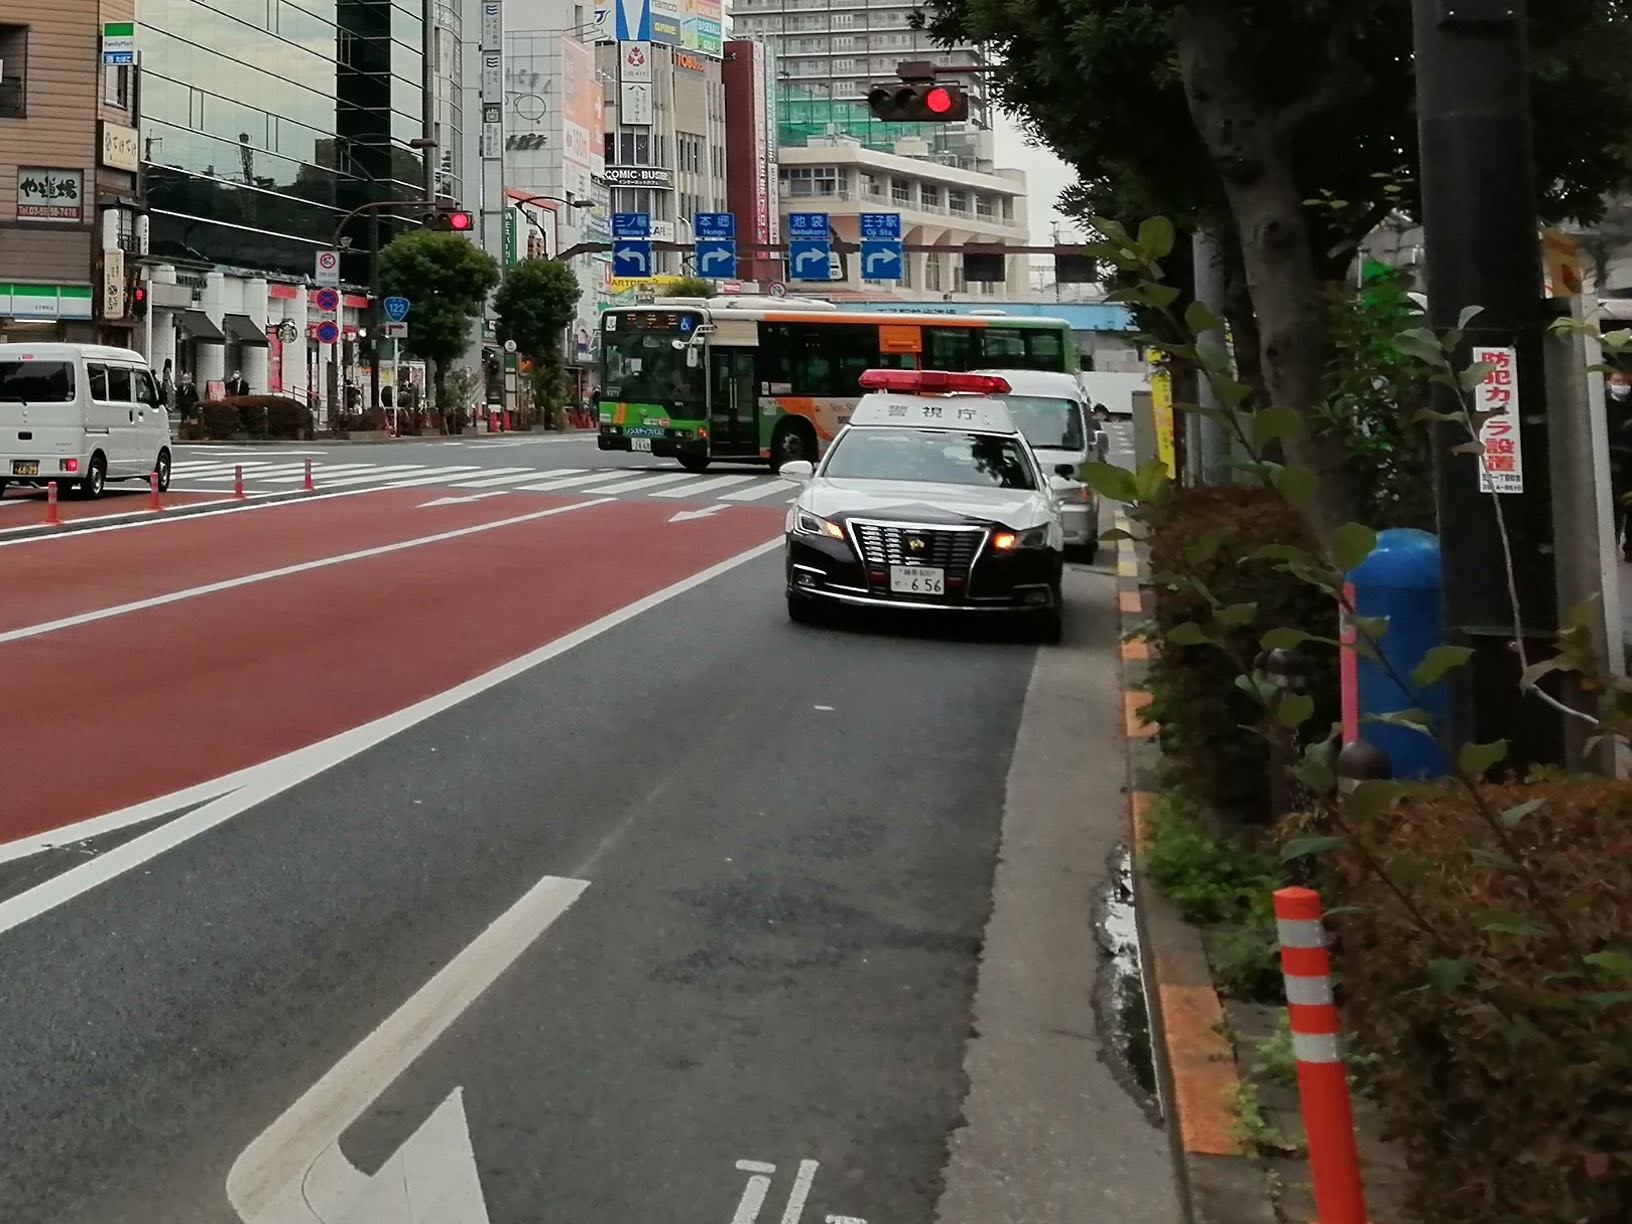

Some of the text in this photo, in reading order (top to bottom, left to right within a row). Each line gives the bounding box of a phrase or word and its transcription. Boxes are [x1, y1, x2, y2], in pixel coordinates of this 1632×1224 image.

[651, 0, 678, 13] namco
[615, 215, 647, 227] 三ノ輪
[700, 216, 730, 228] 本郷
[793, 215, 824, 228] 池袋
[864, 215, 898, 228] 王子駅
[866, 228, 877, 238] Oji
[389, 303, 405, 313] 122
[888, 404, 977, 420] 警視庁
[1481, 351, 1516, 472] 防犯カラ設置
